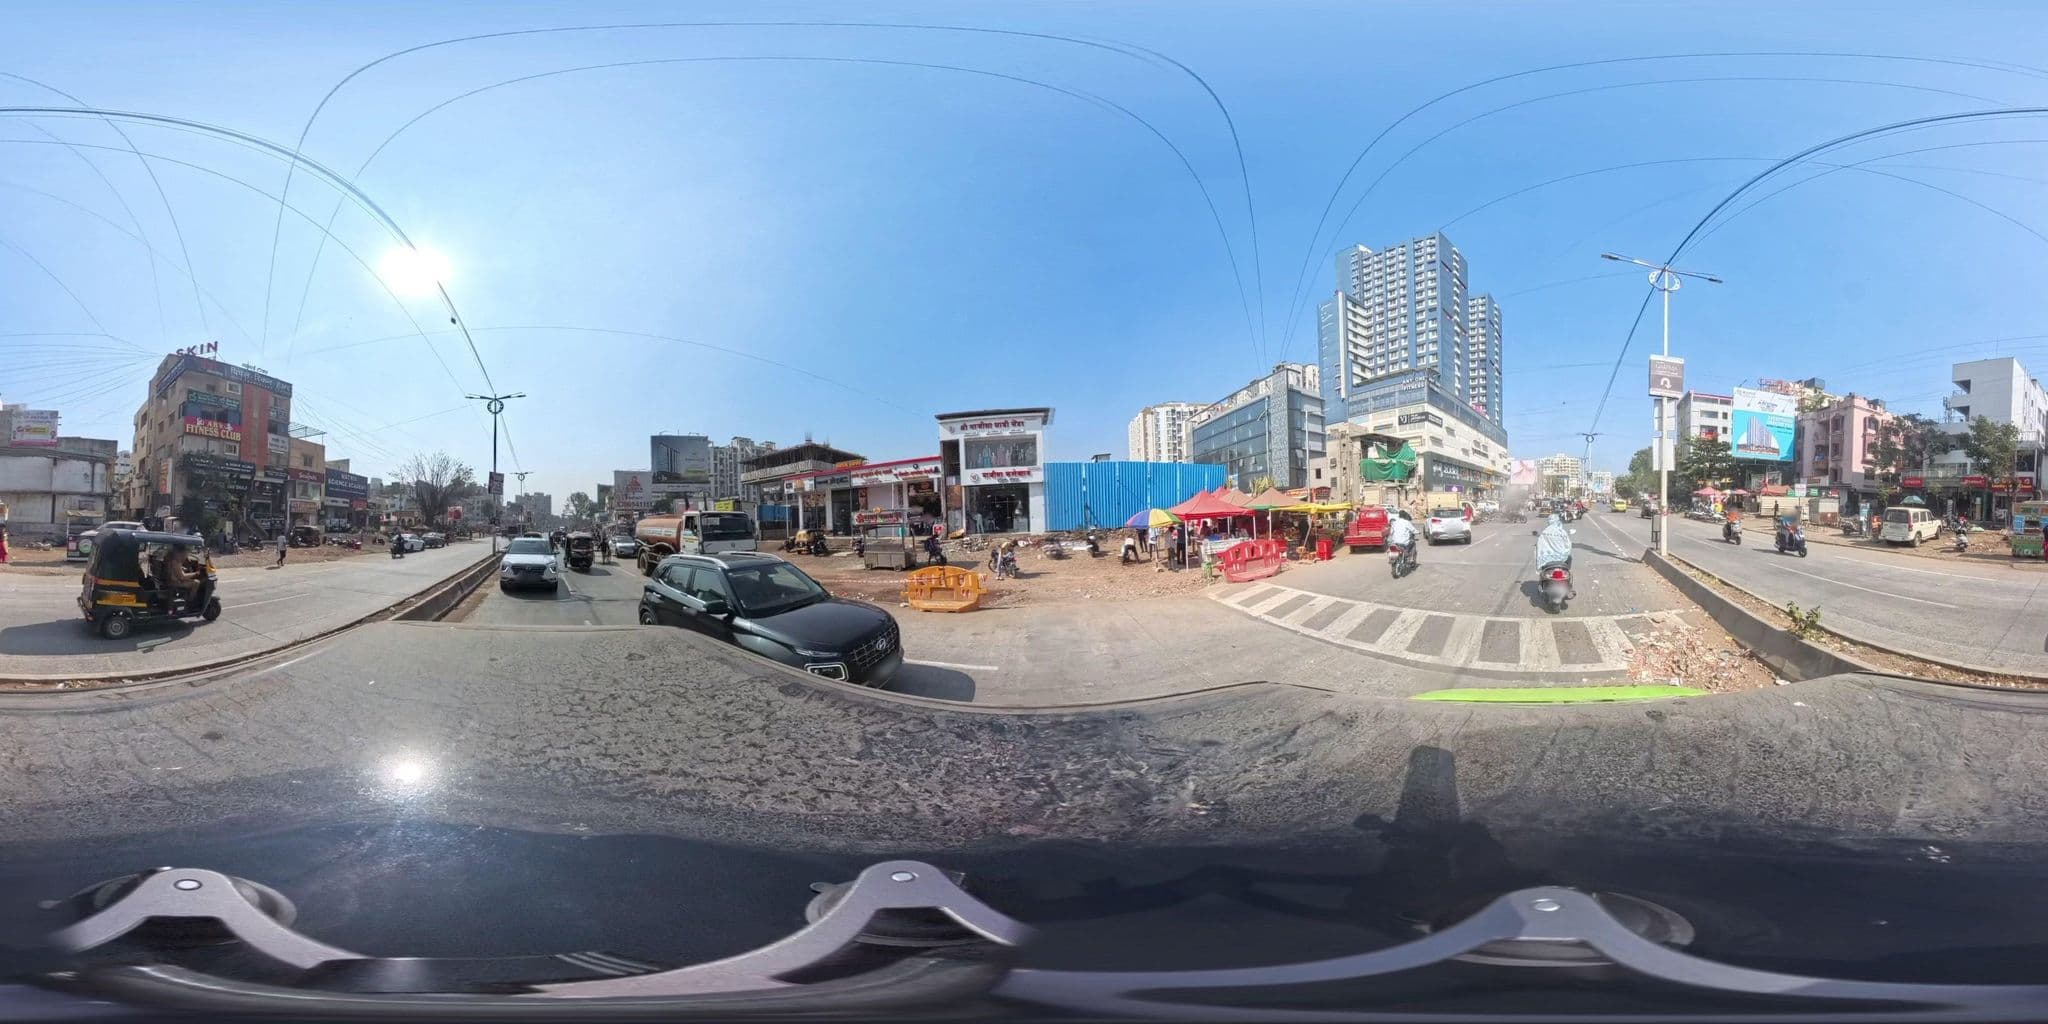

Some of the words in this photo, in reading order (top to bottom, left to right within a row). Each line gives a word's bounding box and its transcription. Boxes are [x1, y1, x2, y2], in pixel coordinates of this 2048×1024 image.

[176, 341, 218, 356] SKIN
[186, 424, 218, 438] FITNESS
[220, 429, 241, 441] CLUB
